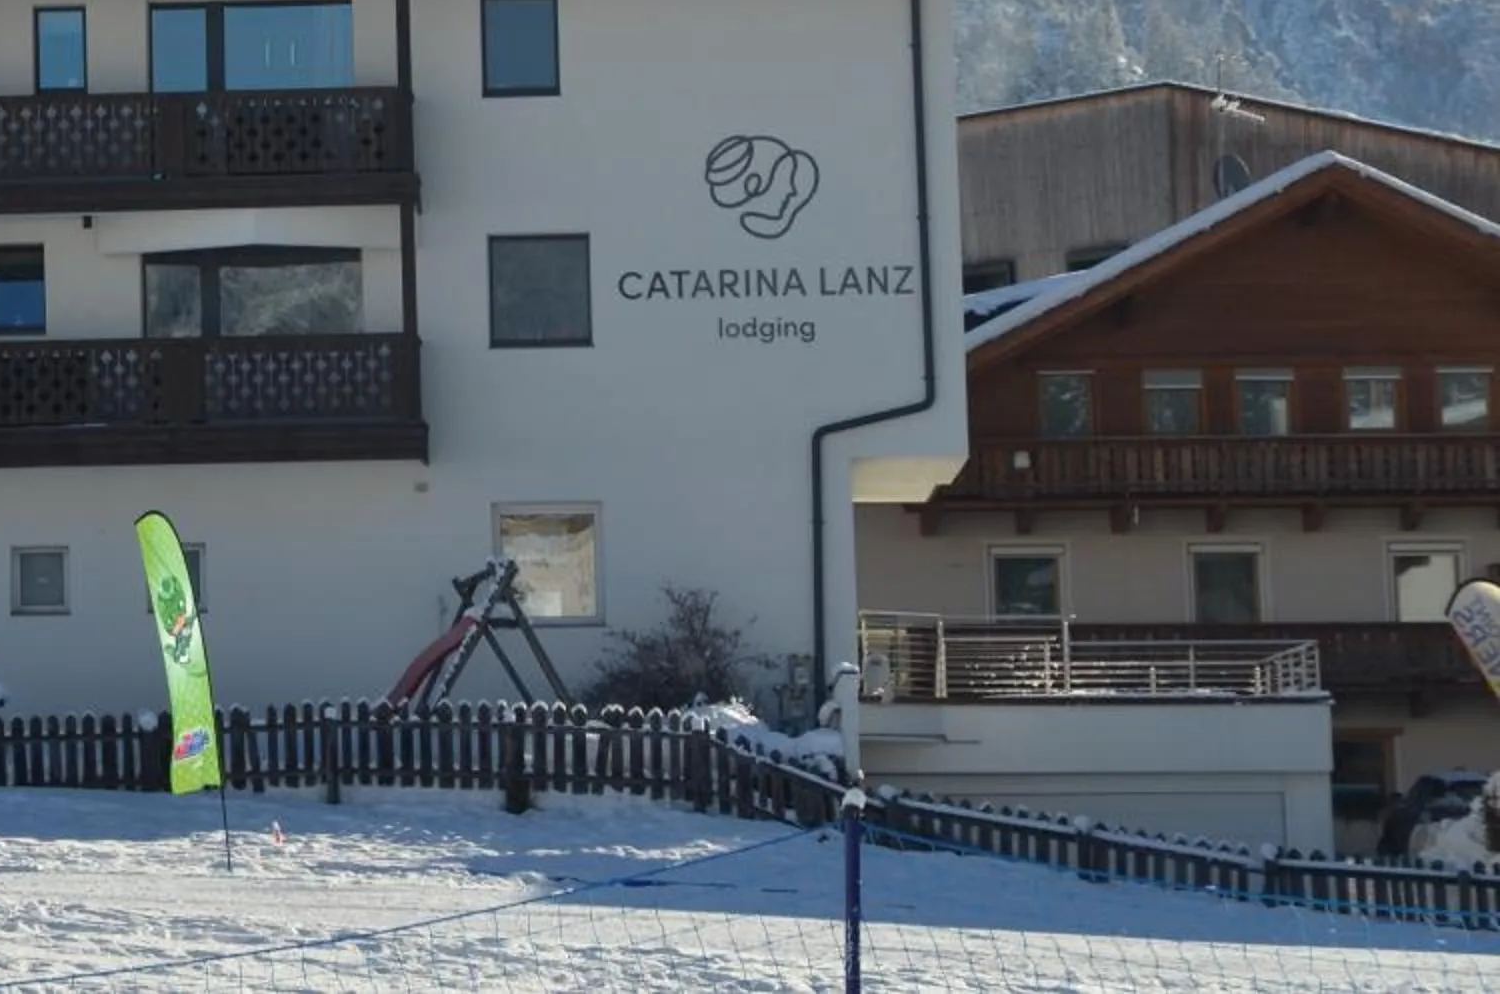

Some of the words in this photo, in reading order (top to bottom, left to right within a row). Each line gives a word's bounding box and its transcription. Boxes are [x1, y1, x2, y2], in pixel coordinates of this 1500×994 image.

[617, 267, 808, 301] CATARINA
[819, 265, 915, 297] LANZ
[718, 316, 817, 344] lodging
